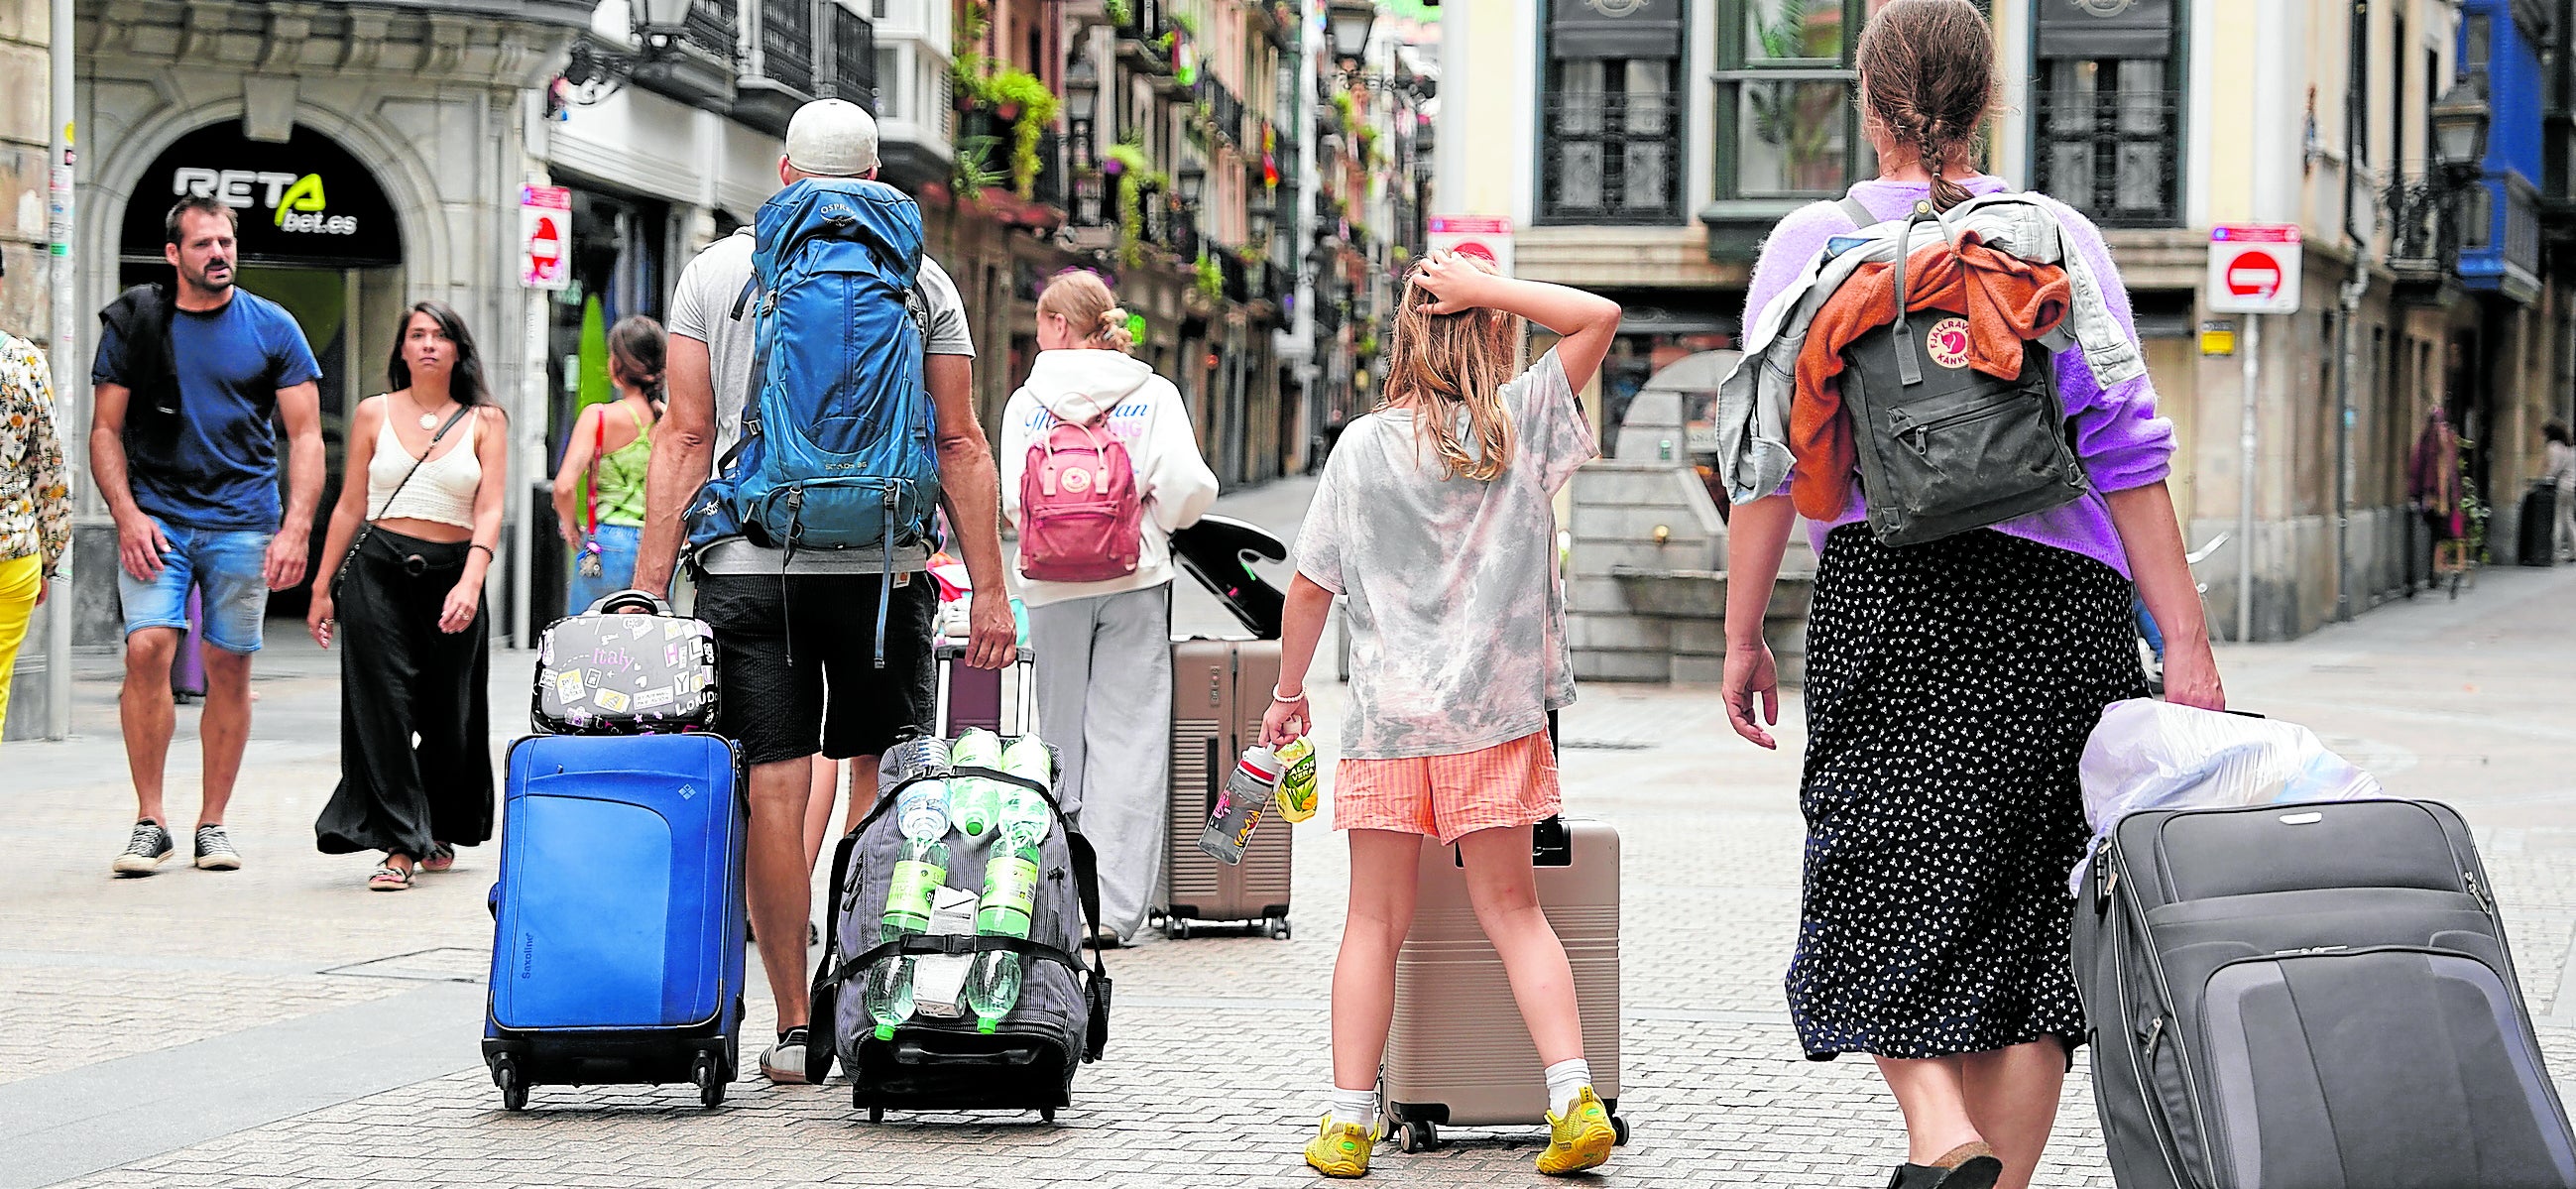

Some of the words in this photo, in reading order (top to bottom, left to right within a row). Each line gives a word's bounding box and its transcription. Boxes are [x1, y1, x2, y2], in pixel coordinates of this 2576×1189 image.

[173, 168, 326, 227] RETA
[282, 209, 358, 236] bet.es
[592, 647, 636, 672] Italy
[676, 666, 713, 692] YOU
[1290, 760, 1316, 775] ALOE
[1292, 768, 1315, 781] VERA
